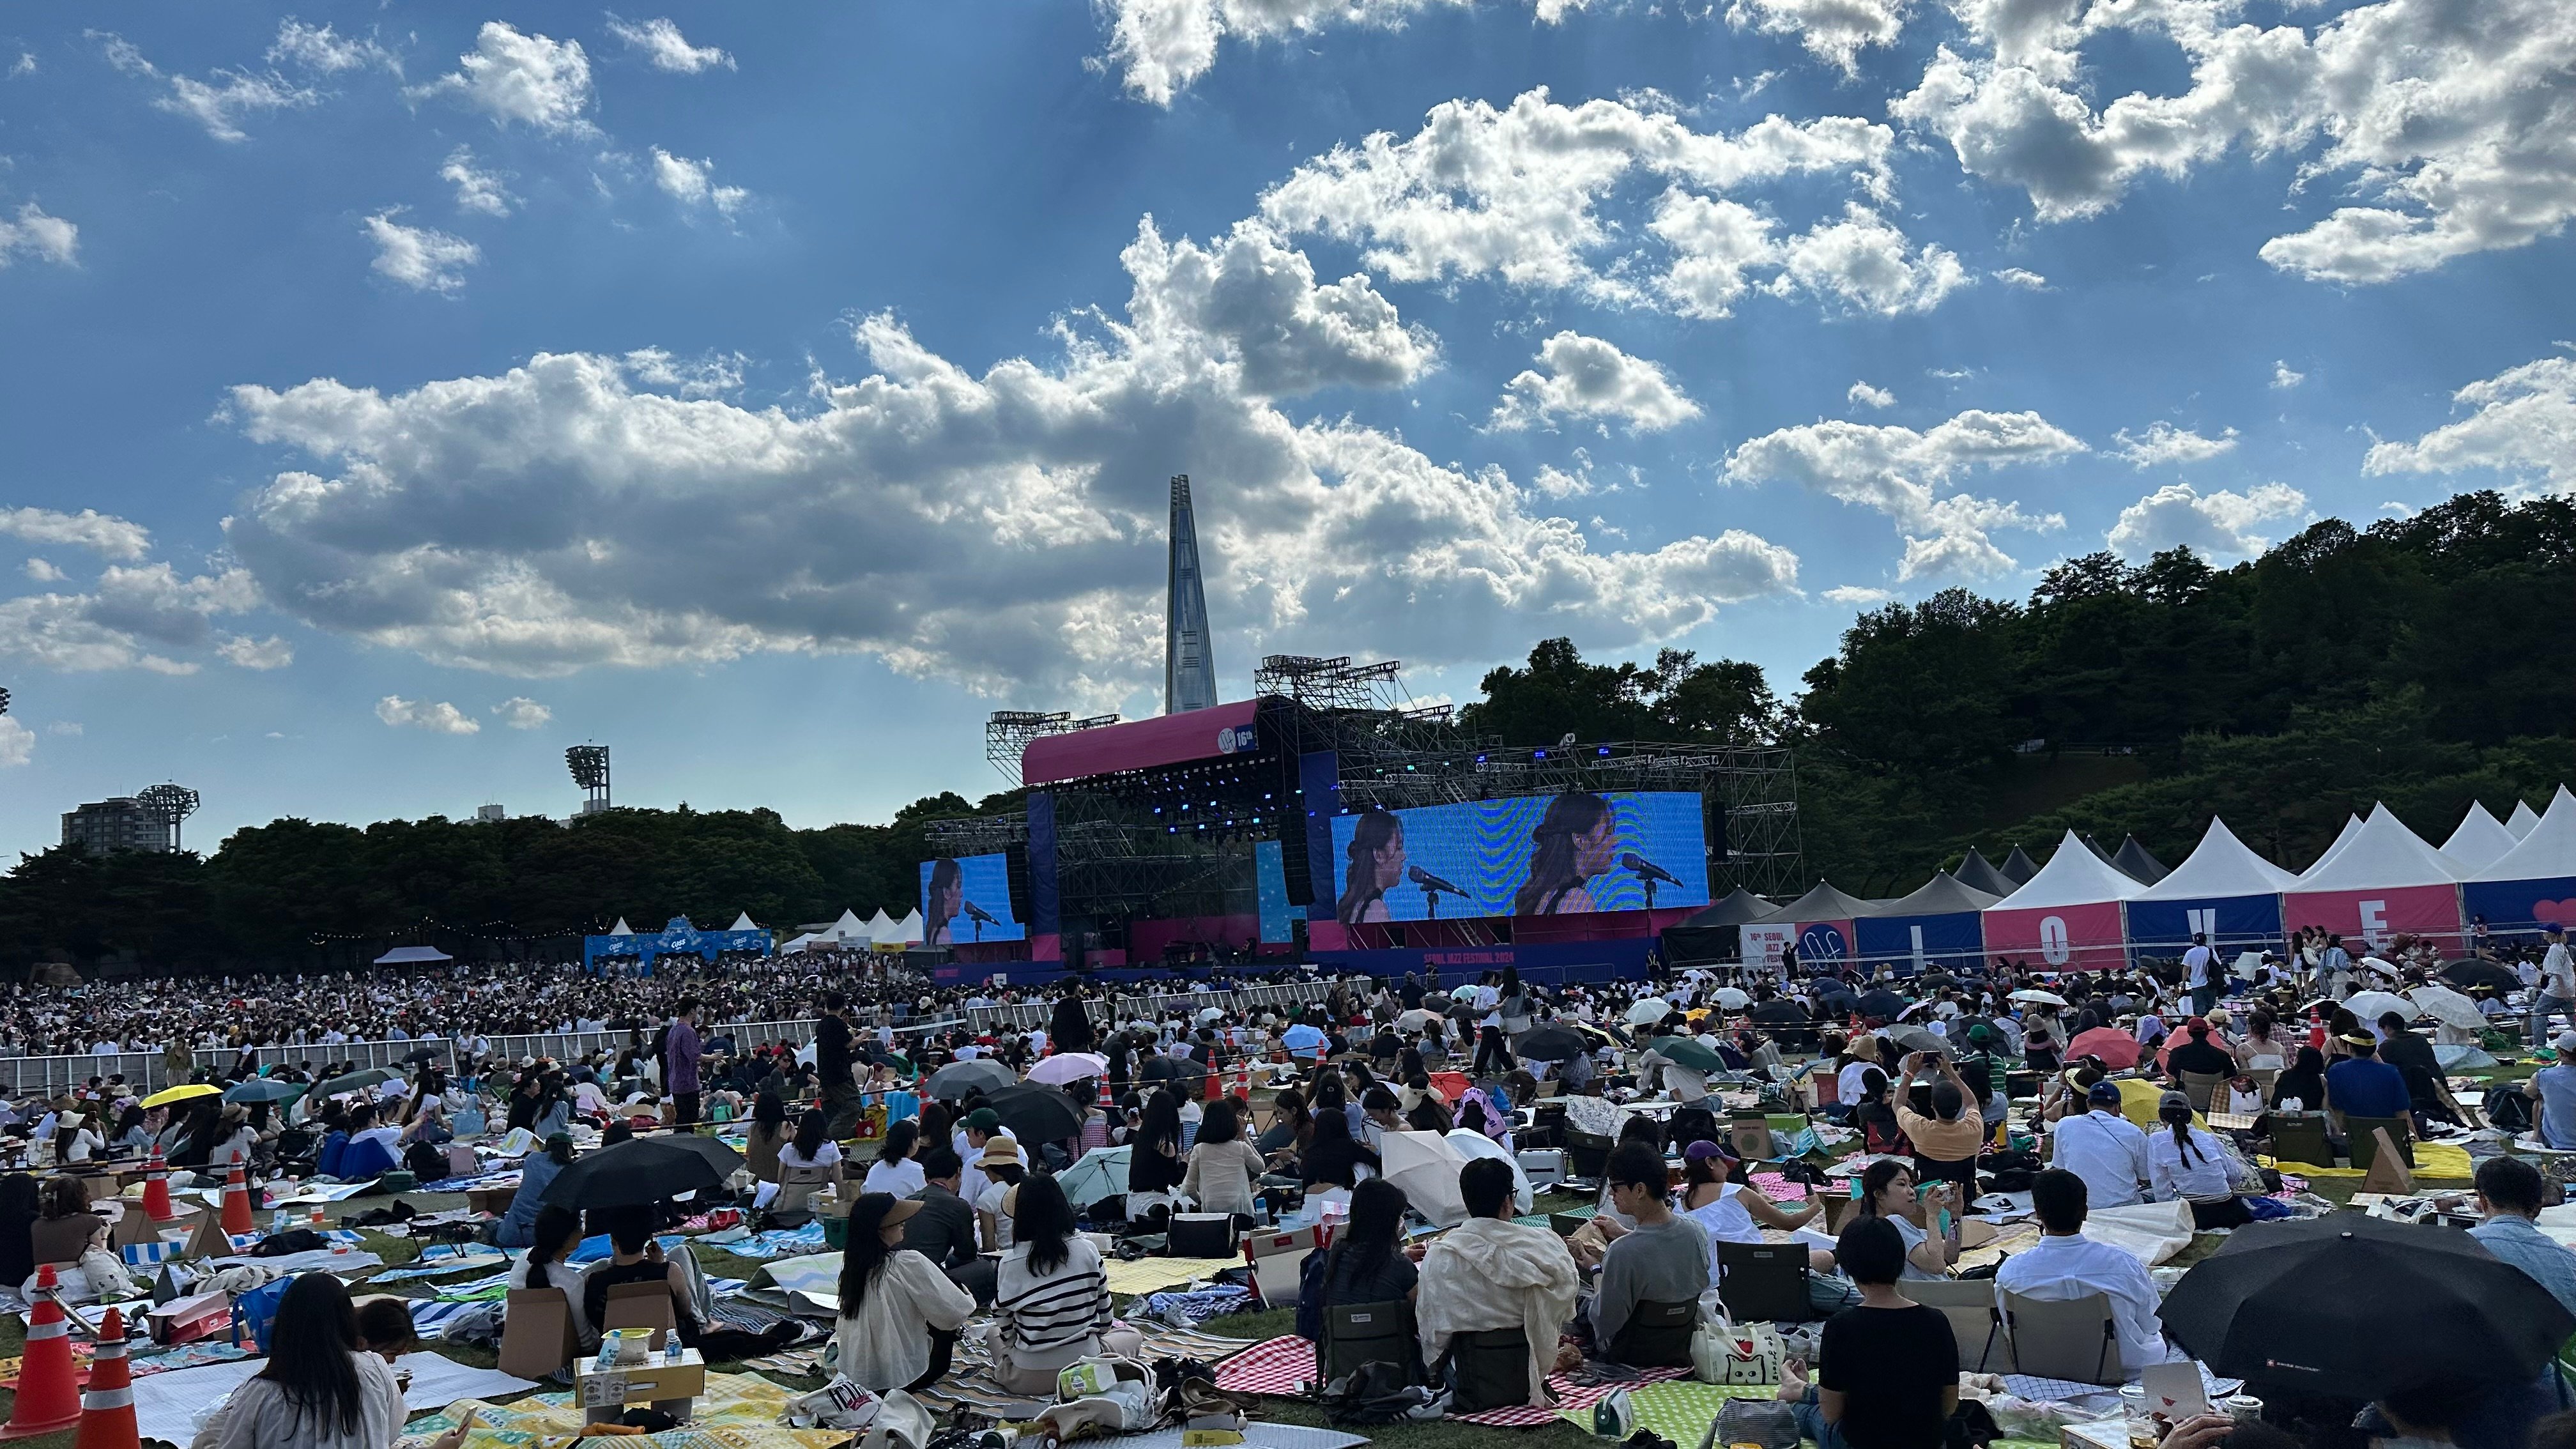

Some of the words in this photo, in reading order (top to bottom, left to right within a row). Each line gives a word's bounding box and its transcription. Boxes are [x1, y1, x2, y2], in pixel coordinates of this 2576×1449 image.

[1236, 730, 1253, 747] 16th
[1764, 932, 1784, 941] SEOUL
[1765, 943, 1780, 952] JAZZ
[1423, 953, 1446, 965] SEOUL
[1446, 953, 1462, 964] JAZZ
[1462, 952, 1494, 963] FESTIVAL
[1494, 951, 1515, 963] 2024
